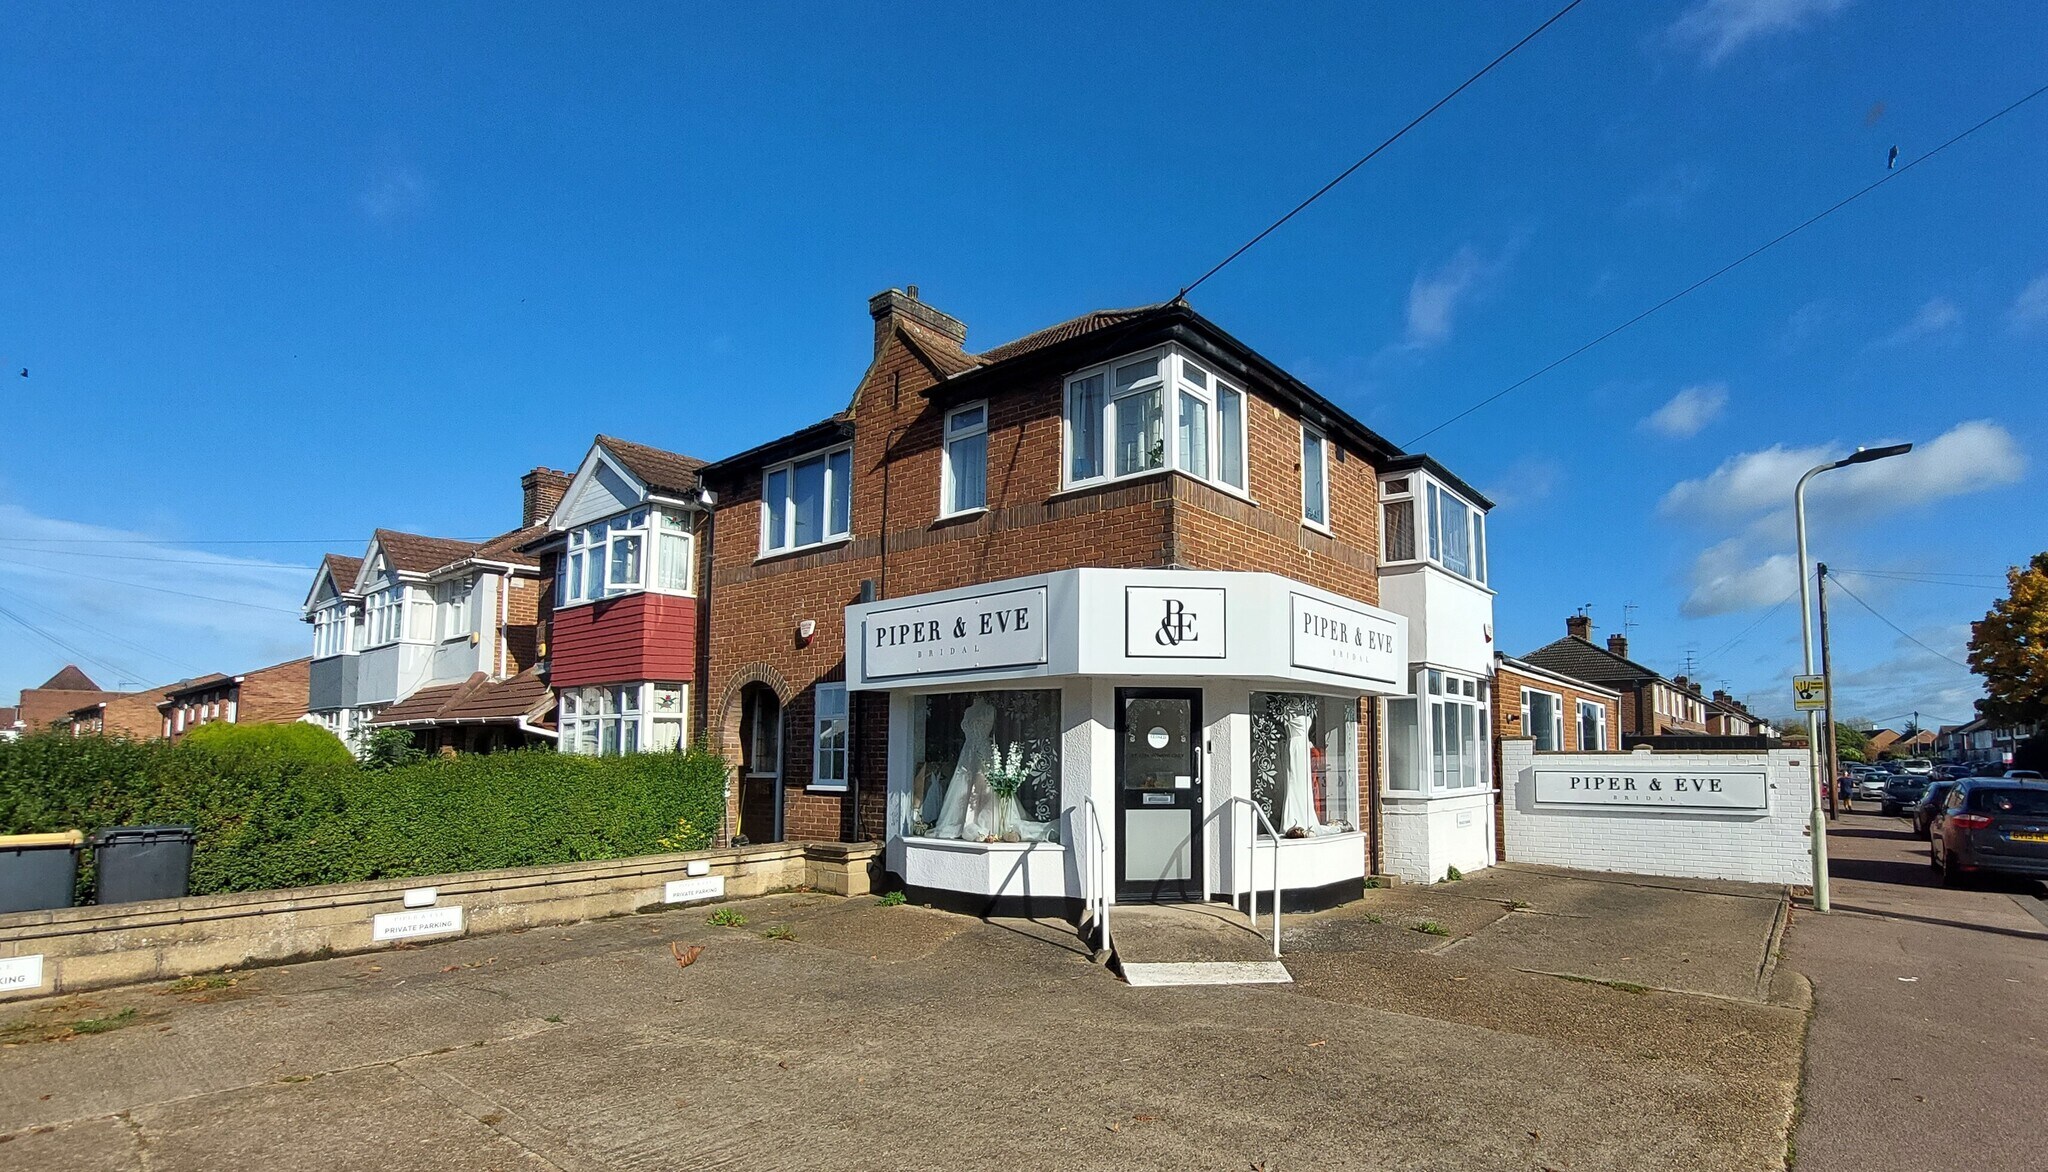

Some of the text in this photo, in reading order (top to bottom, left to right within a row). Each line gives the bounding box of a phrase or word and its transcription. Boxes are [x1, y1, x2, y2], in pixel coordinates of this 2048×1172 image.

[876, 607, 1030, 648] PIPER & EVE
[1303, 612, 1393, 654] PIPER & EVE
[917, 645, 980, 659] BRIDAL
[1332, 649, 1369, 663] BRIDAL
[1570, 776, 1723, 793] PIPER & EVE
[673, 887, 717, 898] PRIVATE PARKING
[384, 920, 453, 934] PRIVATE PARKING
